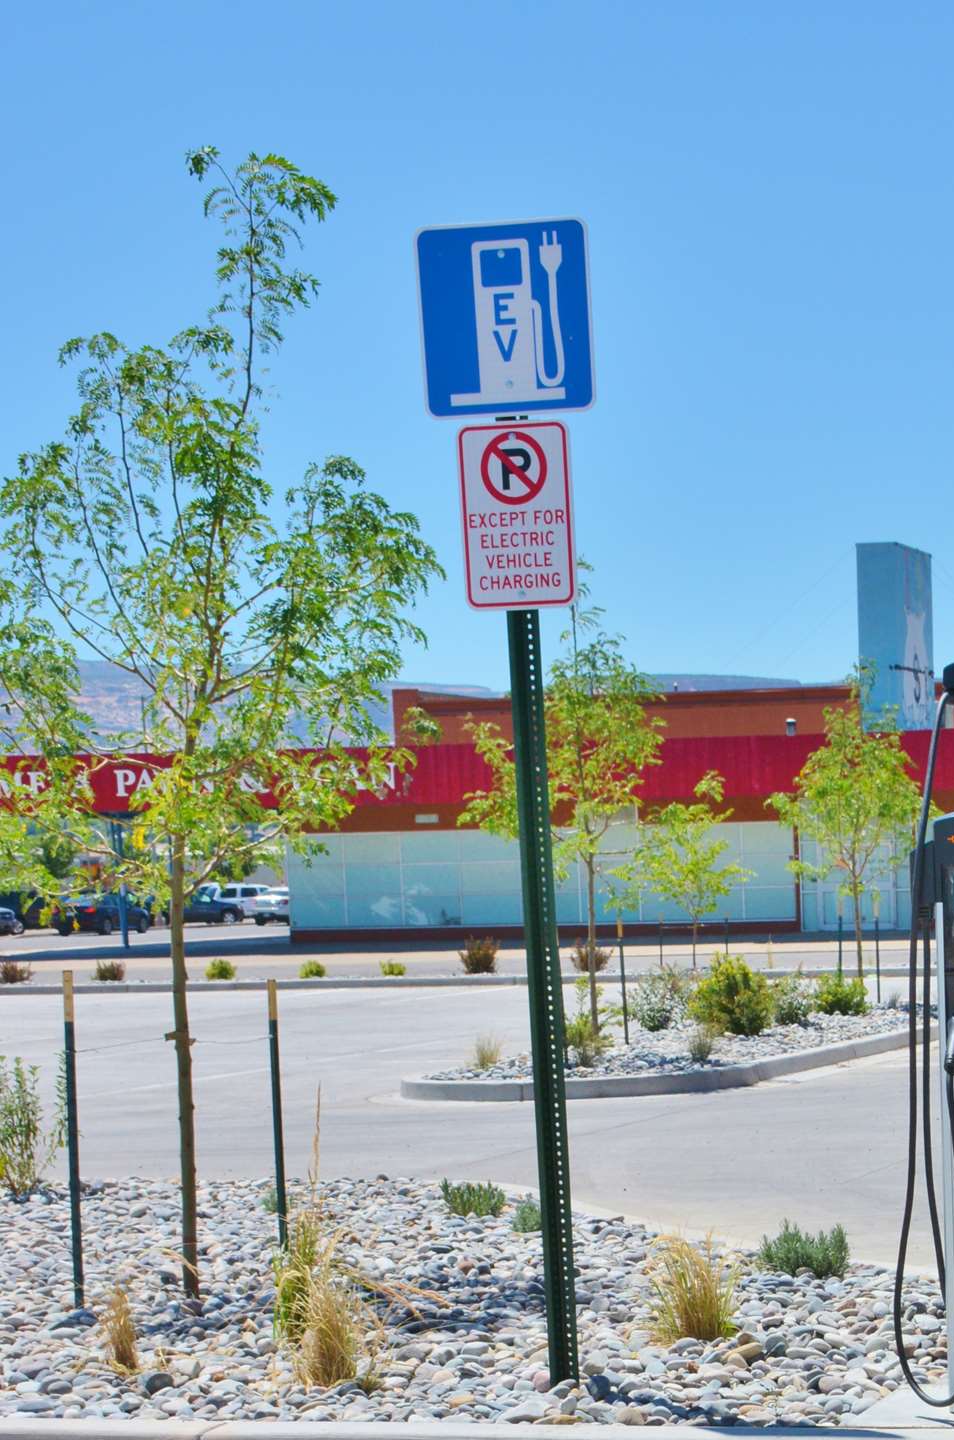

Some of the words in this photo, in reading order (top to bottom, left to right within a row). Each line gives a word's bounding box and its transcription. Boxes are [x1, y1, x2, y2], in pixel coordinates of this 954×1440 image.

[492, 292, 518, 362] EV
[468, 511, 527, 528] EXCEPT
[533, 509, 565, 525] FOR
[480, 530, 554, 549] ELECTRIC
[486, 552, 552, 569] VEHICLE
[480, 572, 561, 591] CHARGING
